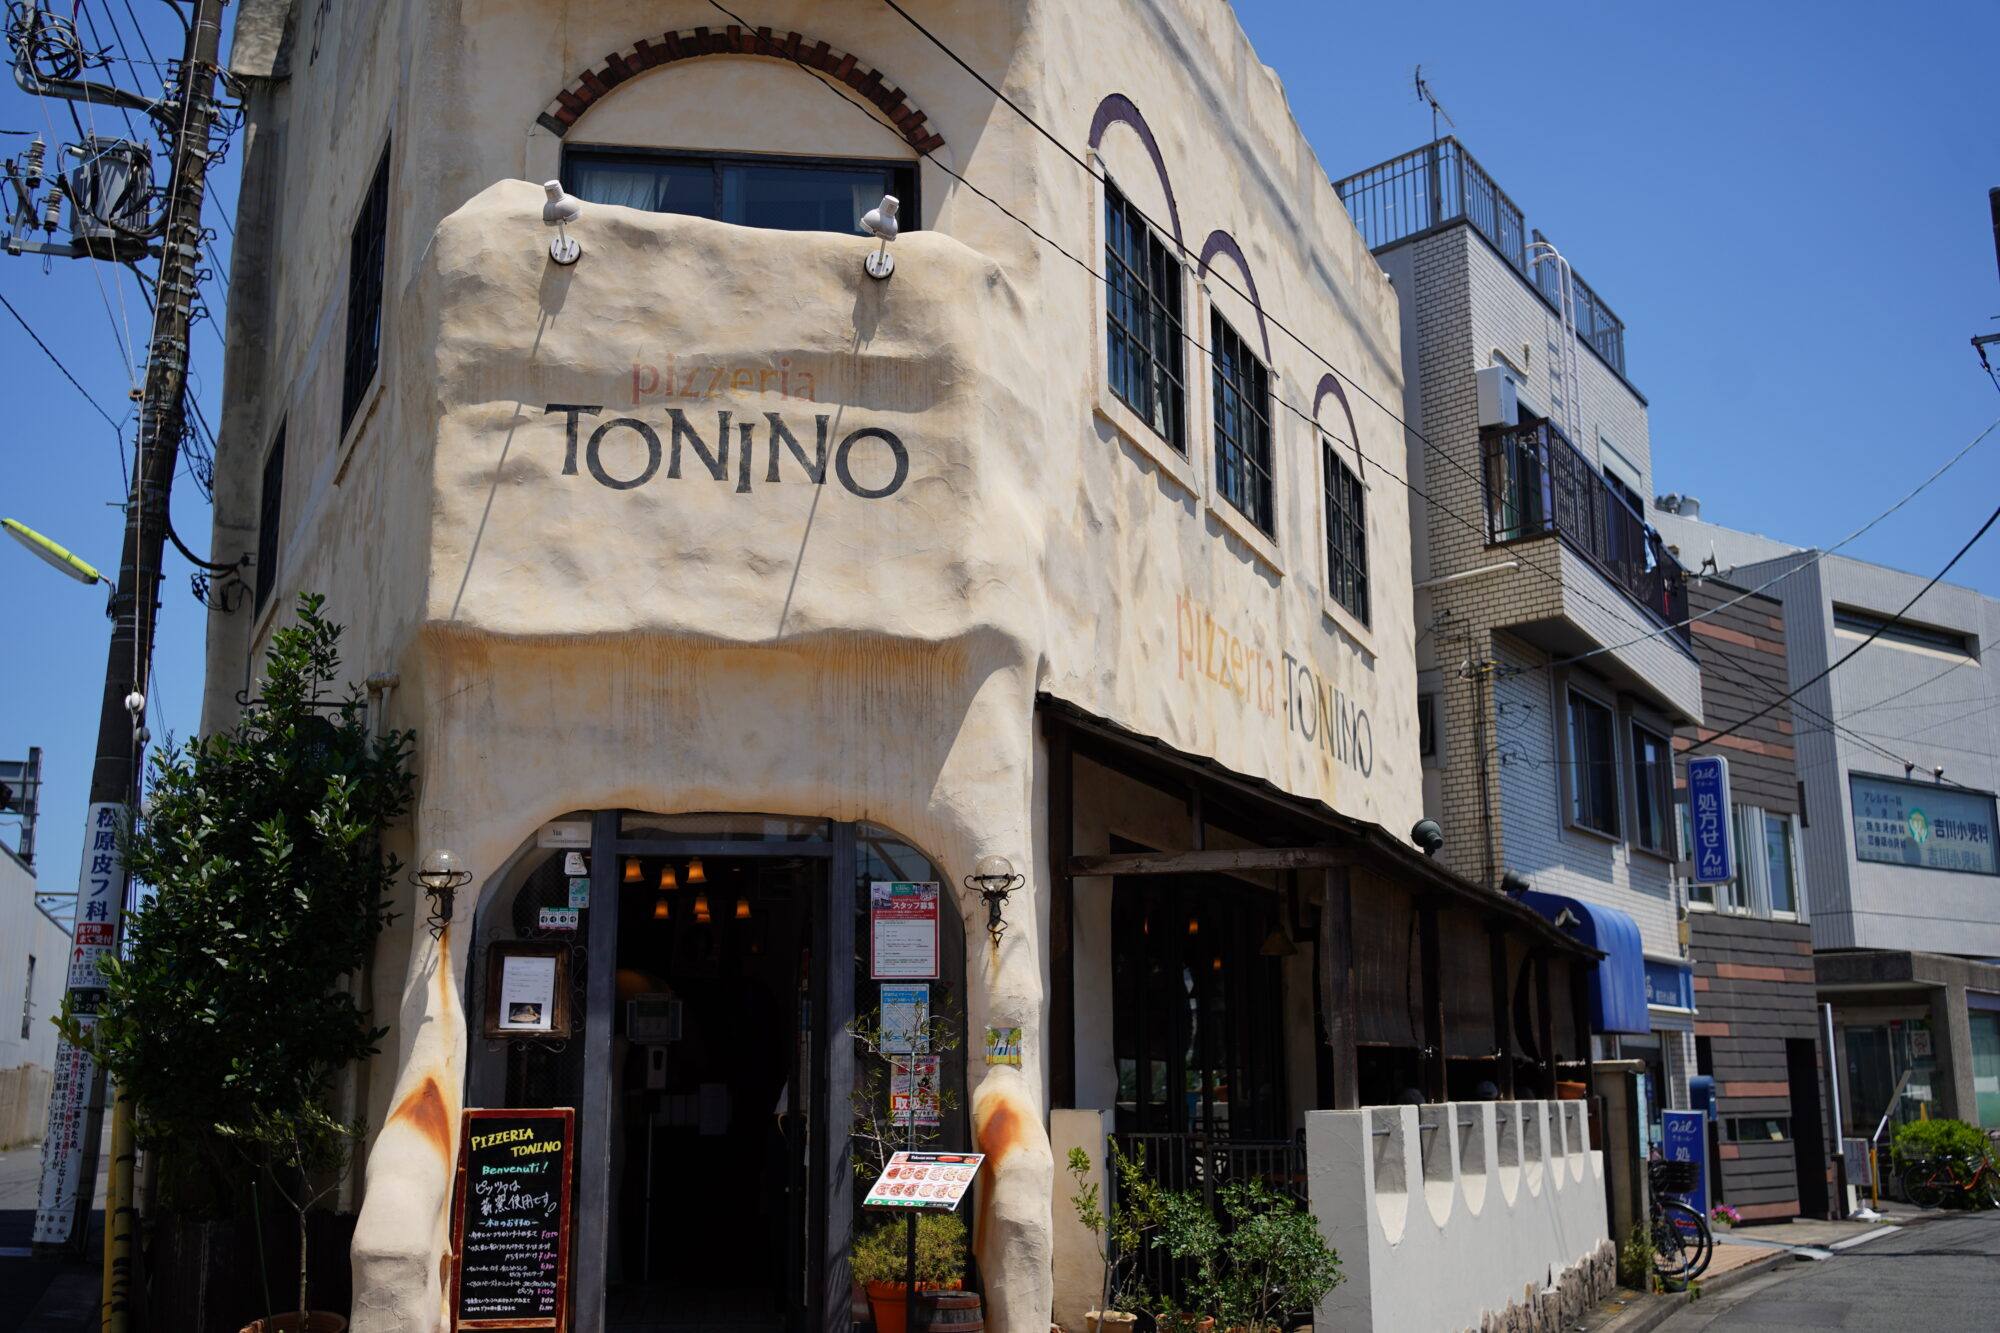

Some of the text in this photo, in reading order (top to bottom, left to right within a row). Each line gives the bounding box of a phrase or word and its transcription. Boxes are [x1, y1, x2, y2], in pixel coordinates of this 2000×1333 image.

[631, 354, 816, 404] pizzeria
[544, 403, 909, 499] TONINO
[1176, 592, 1373, 779] pizzeria TONINO
[1698, 793, 1721, 866] 処方せん
[1934, 819, 1988, 843] 吉川小児科
[86, 808, 118, 922] 松原皮フ科
[893, 902, 935, 910] スタッフ募集
[471, 1128, 534, 1151] PIZZERIA
[511, 1141, 561, 1157] TONINO
